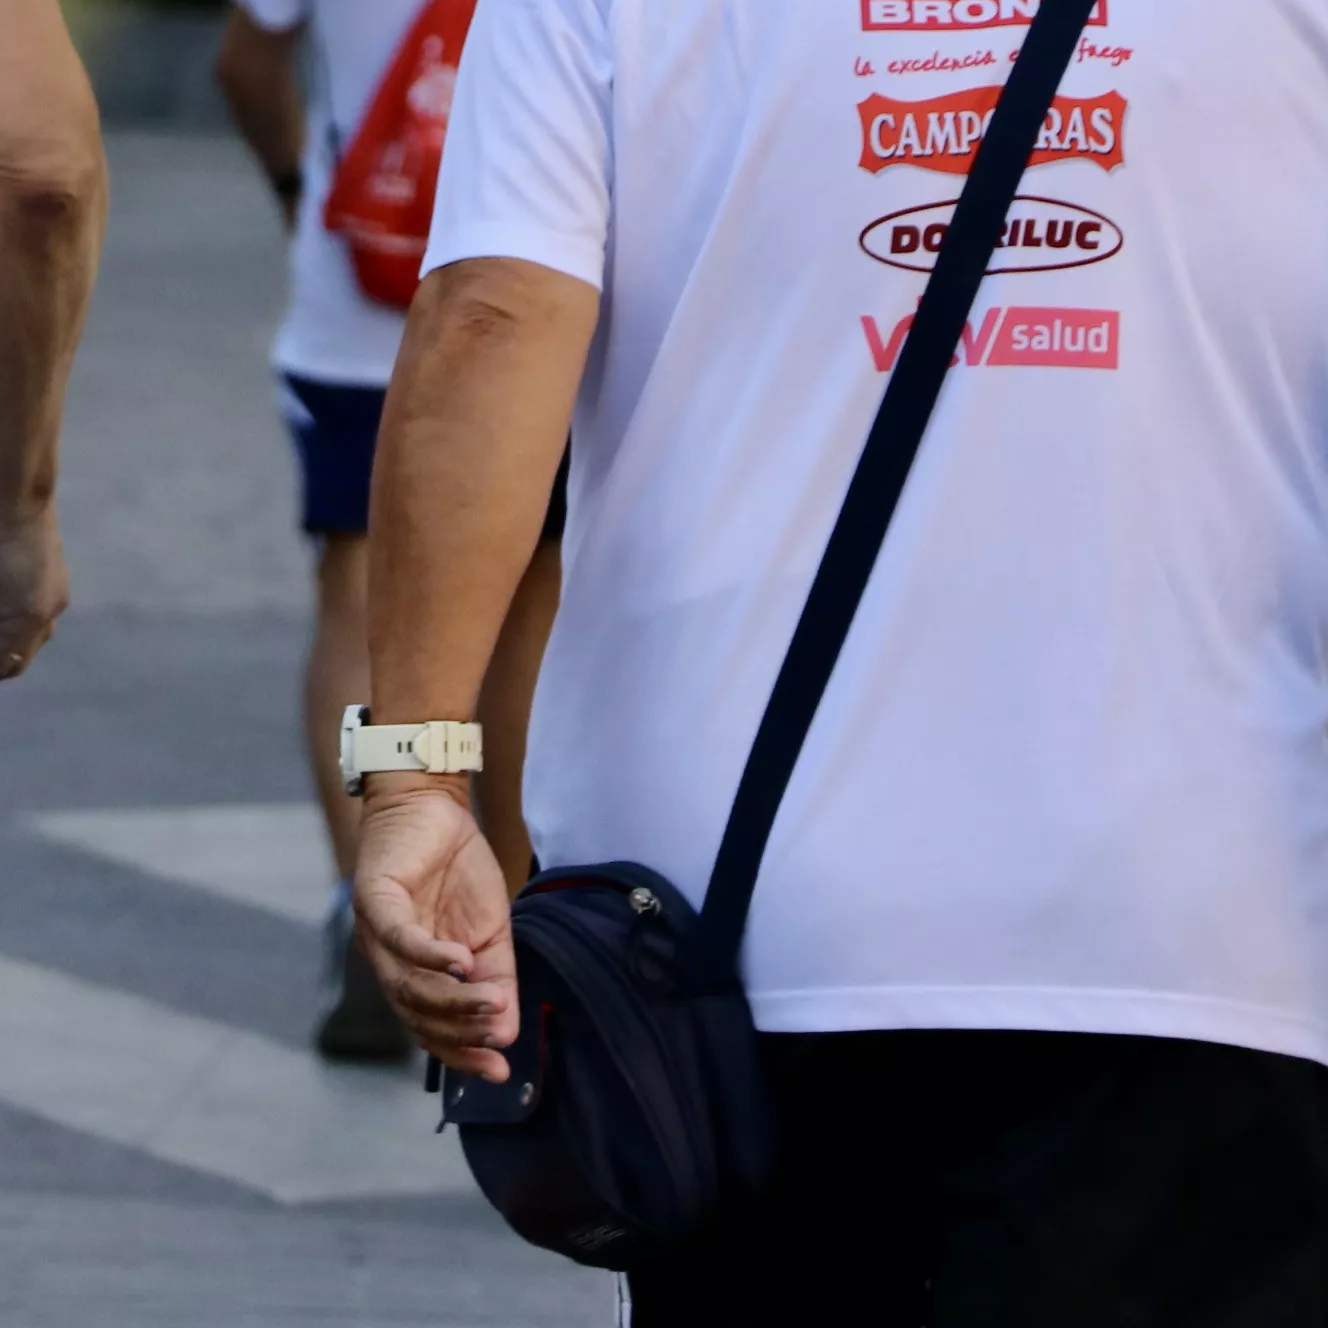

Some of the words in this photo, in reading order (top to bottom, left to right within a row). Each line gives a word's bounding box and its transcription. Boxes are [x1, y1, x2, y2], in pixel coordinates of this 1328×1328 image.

[869, 106, 1117, 159] CAMPRAS
[890, 219, 1102, 255] DOILUC
[1010, 318, 1110, 354] salud
